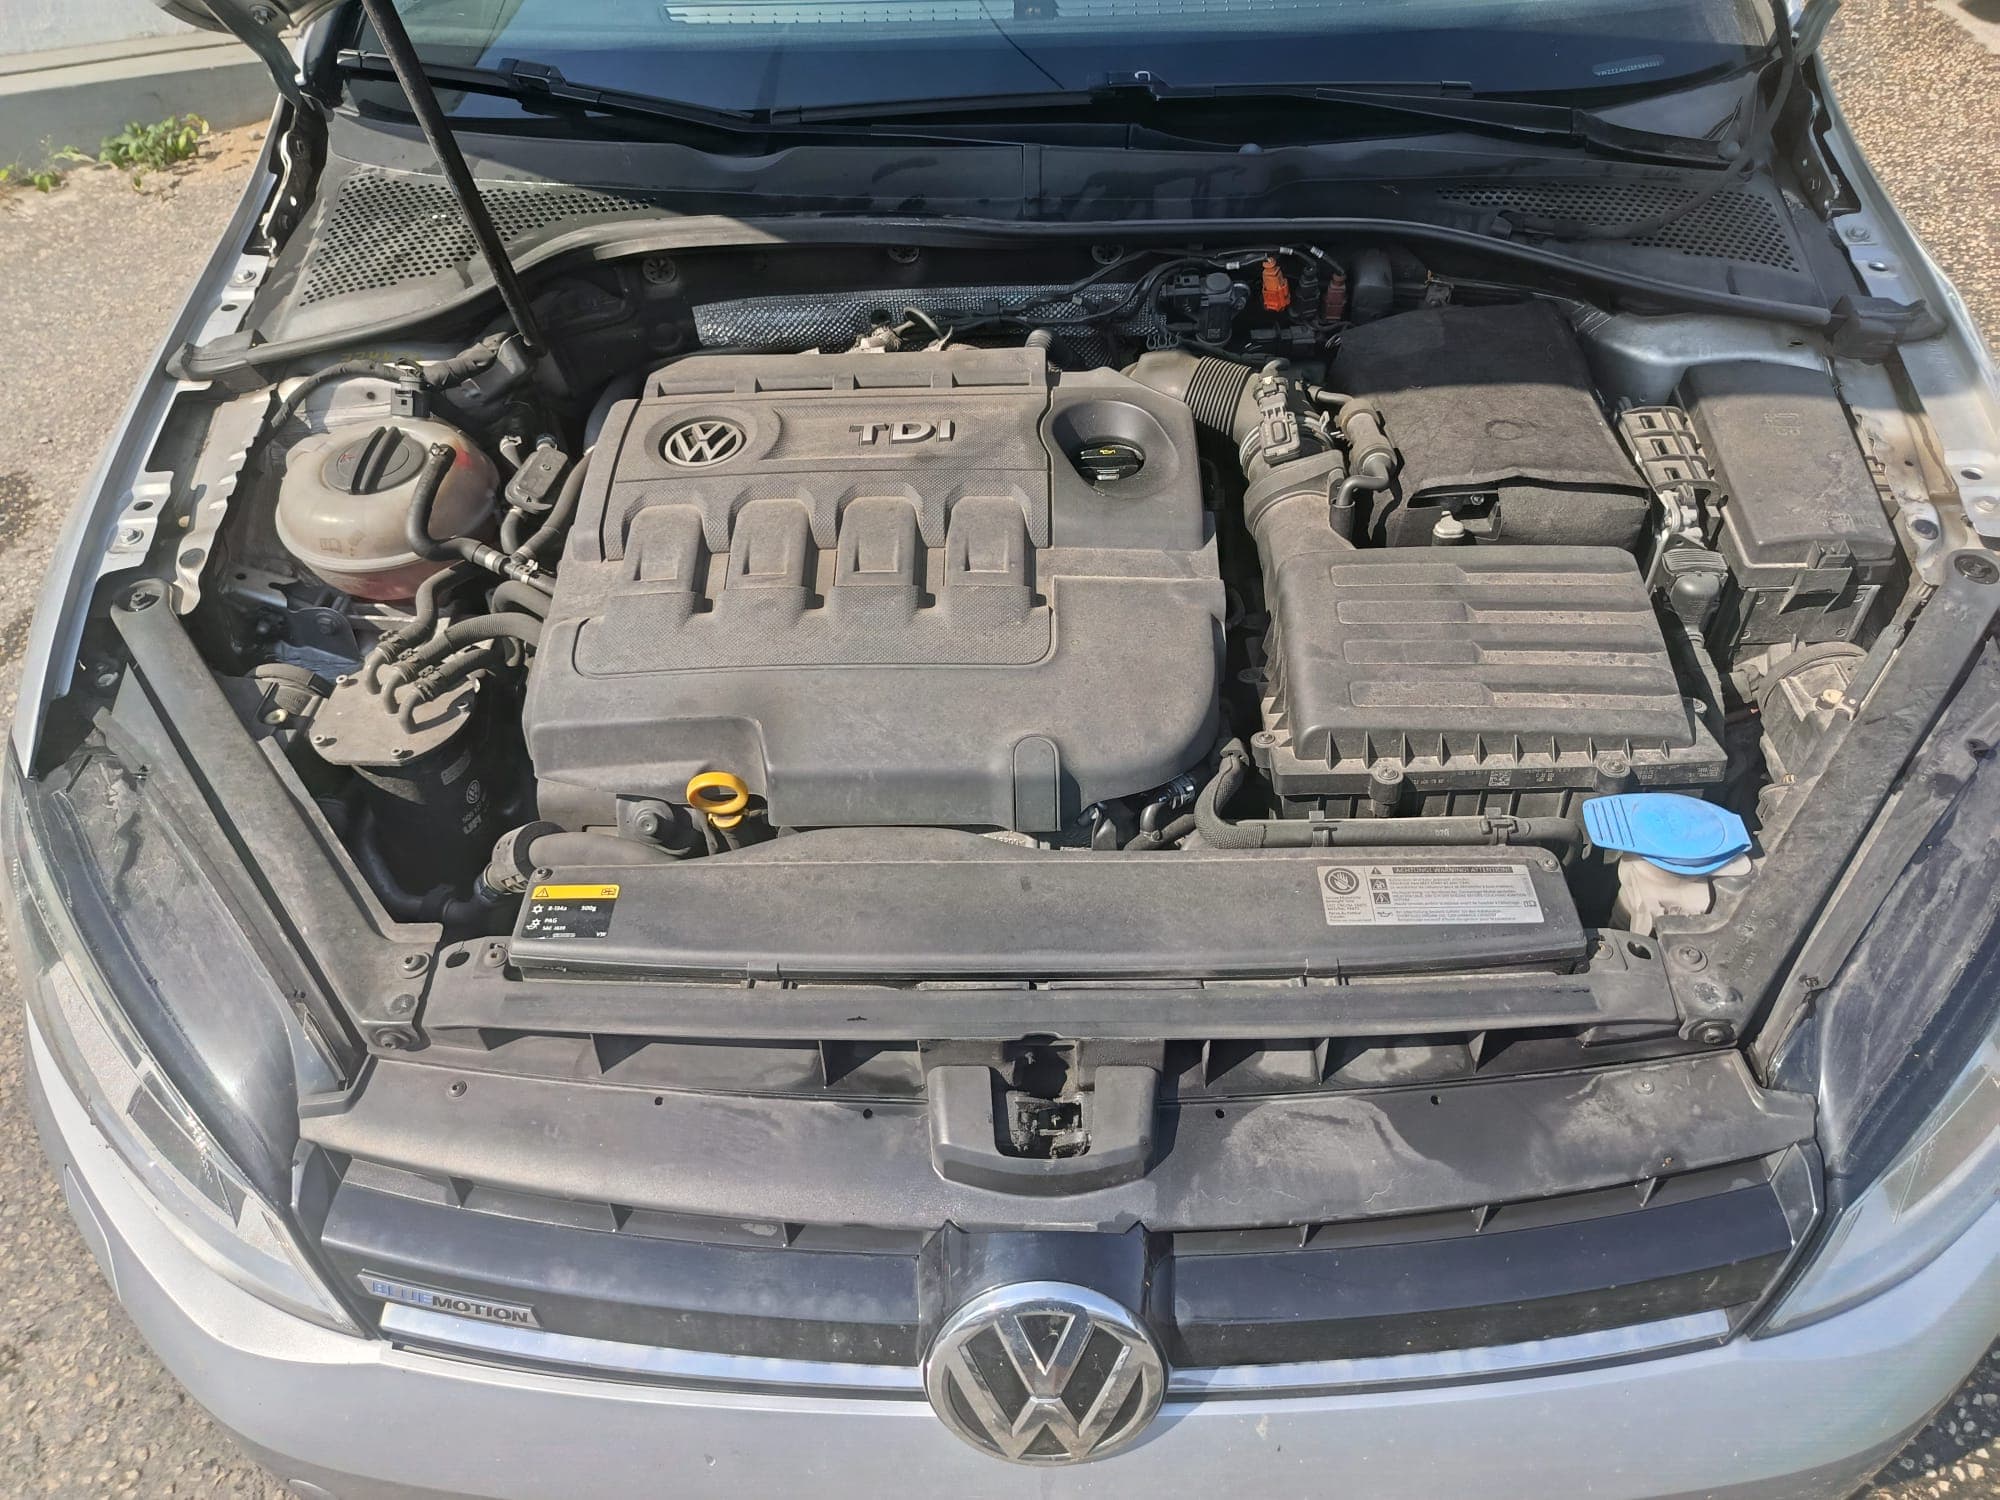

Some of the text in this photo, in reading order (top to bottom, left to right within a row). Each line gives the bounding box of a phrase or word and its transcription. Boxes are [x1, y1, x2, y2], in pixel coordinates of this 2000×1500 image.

[665, 420, 743, 467] VW
[849, 419, 956, 446] TDI
[372, 1280, 529, 1323] BLUEMOTION
[923, 1281, 1168, 1466] VW
